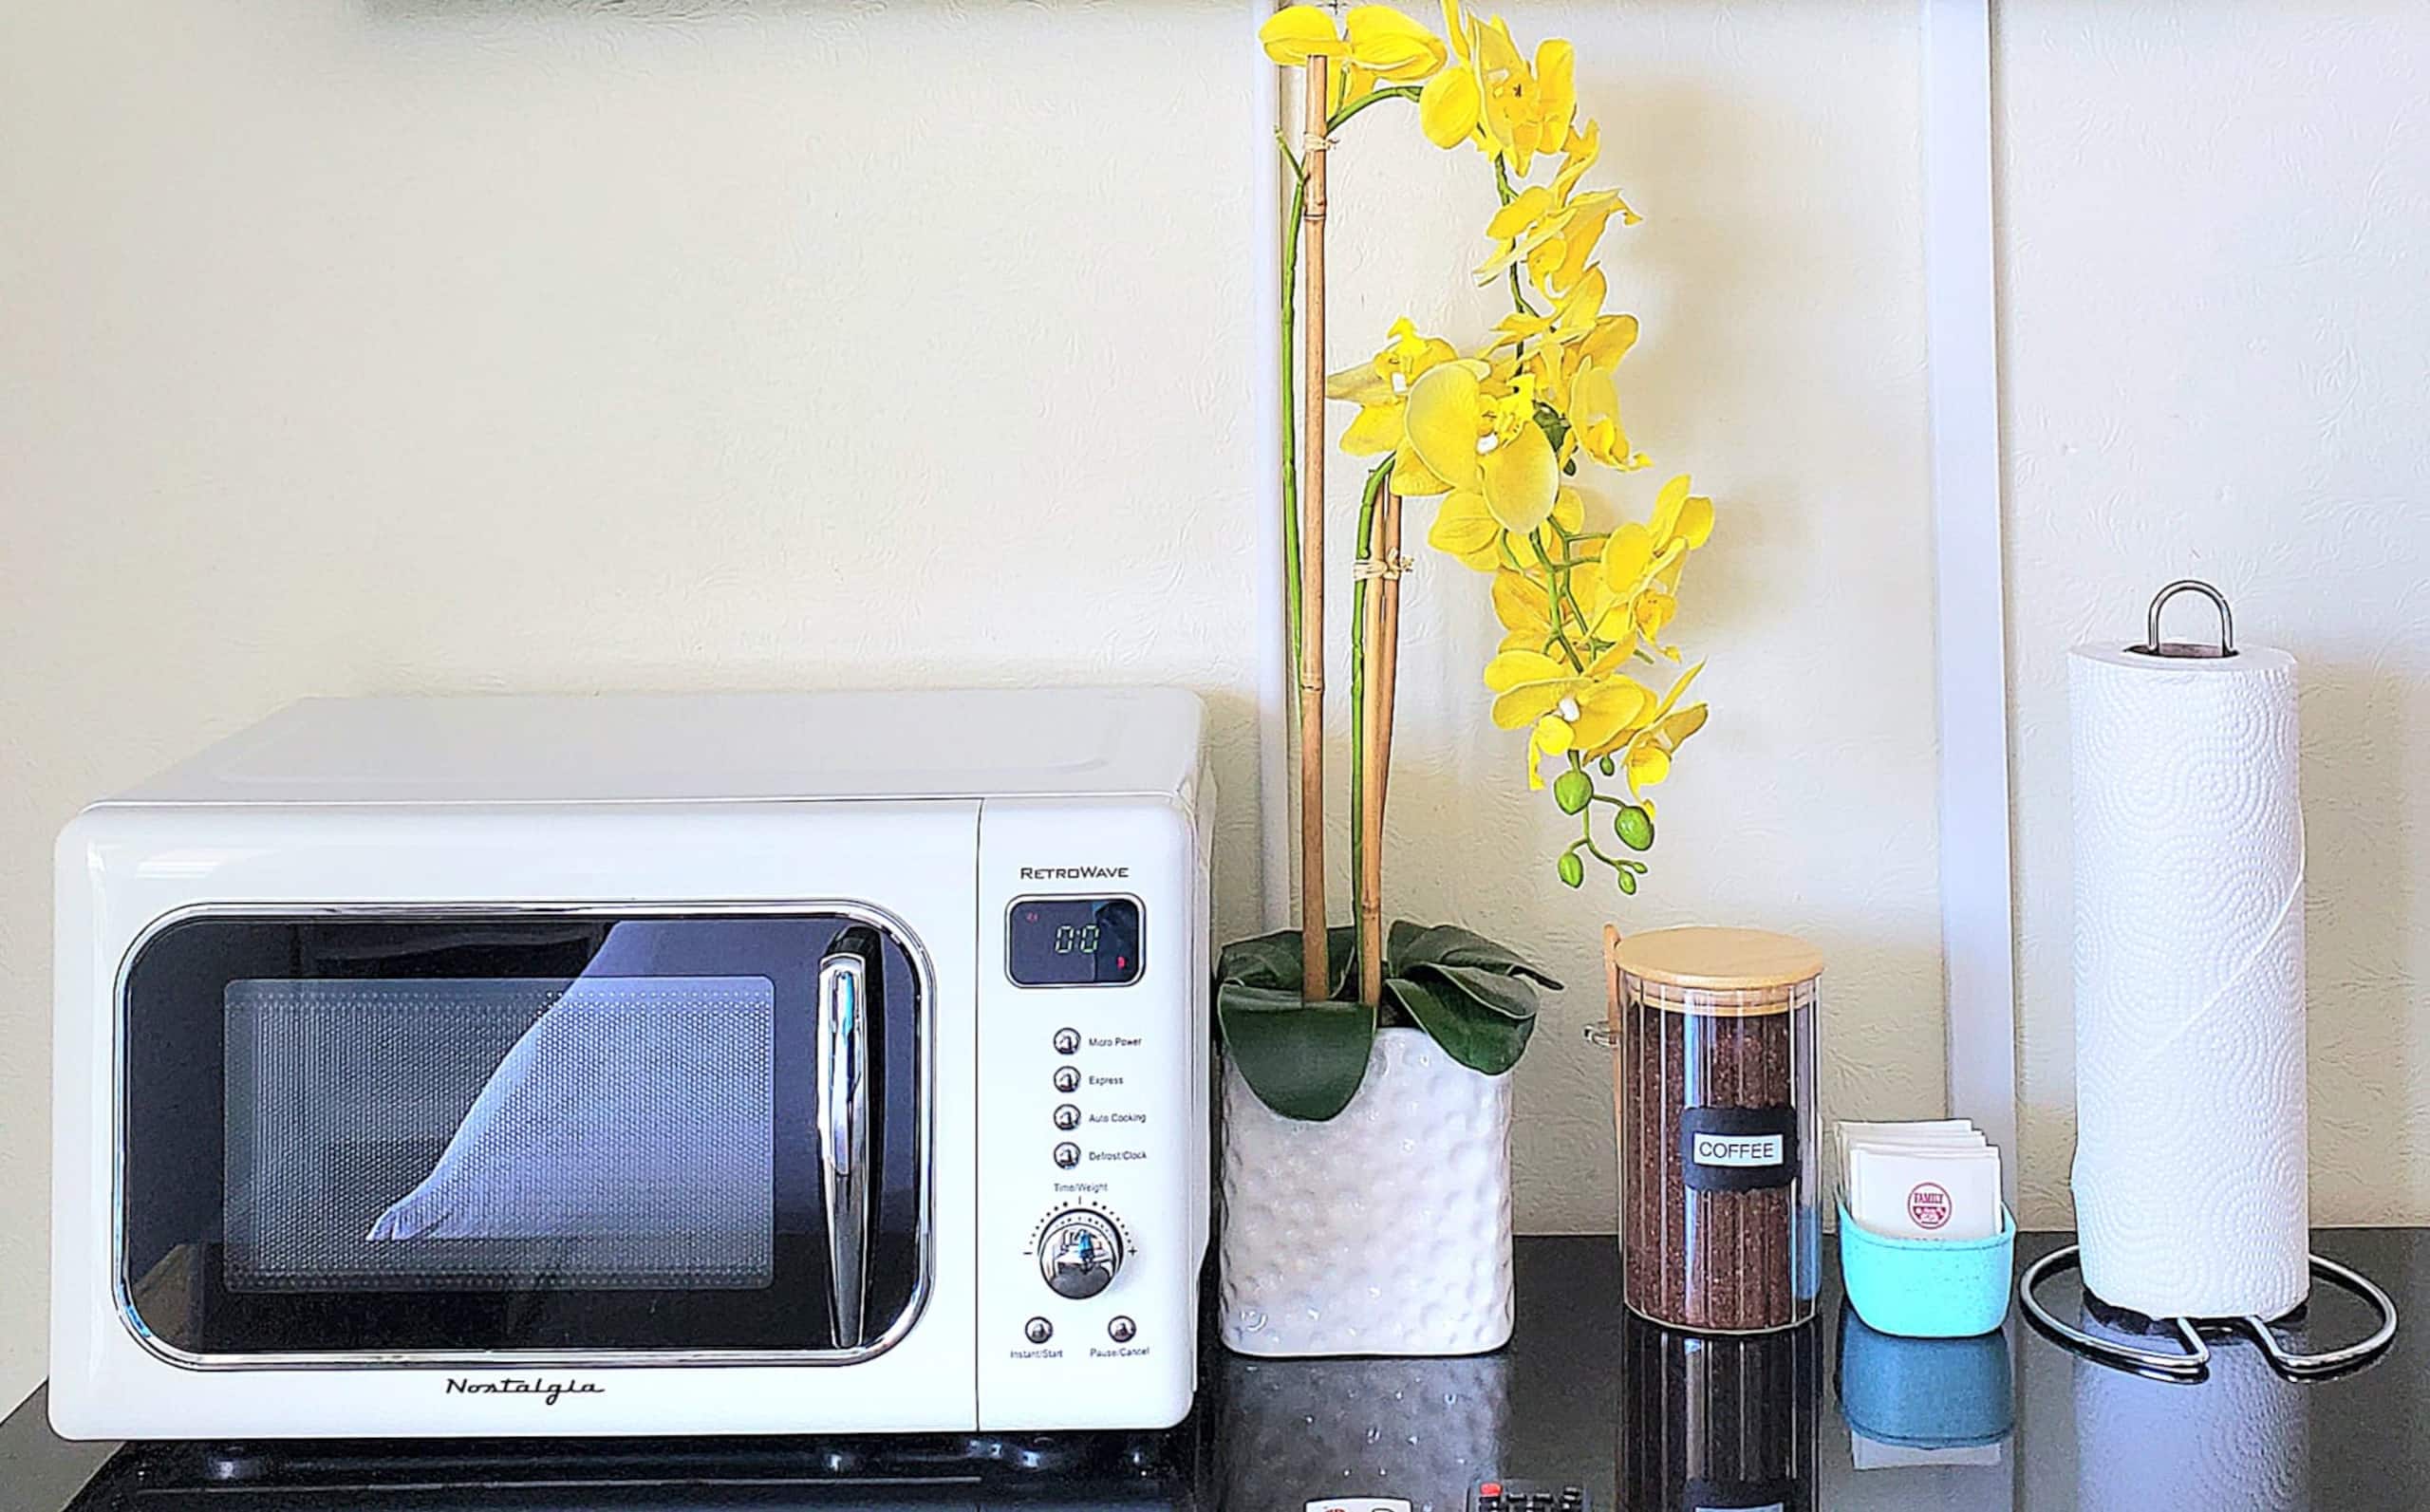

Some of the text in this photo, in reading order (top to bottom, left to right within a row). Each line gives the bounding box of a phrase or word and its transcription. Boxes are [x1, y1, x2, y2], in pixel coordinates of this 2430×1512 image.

[1114, 1036, 1142, 1046] Power
[1089, 1075, 1124, 1086] Express
[1089, 1113, 1147, 1124] Auto Cooking
[1699, 1141, 1774, 1159] COFFEE
[446, 1378, 606, 1406] Nostalgia
